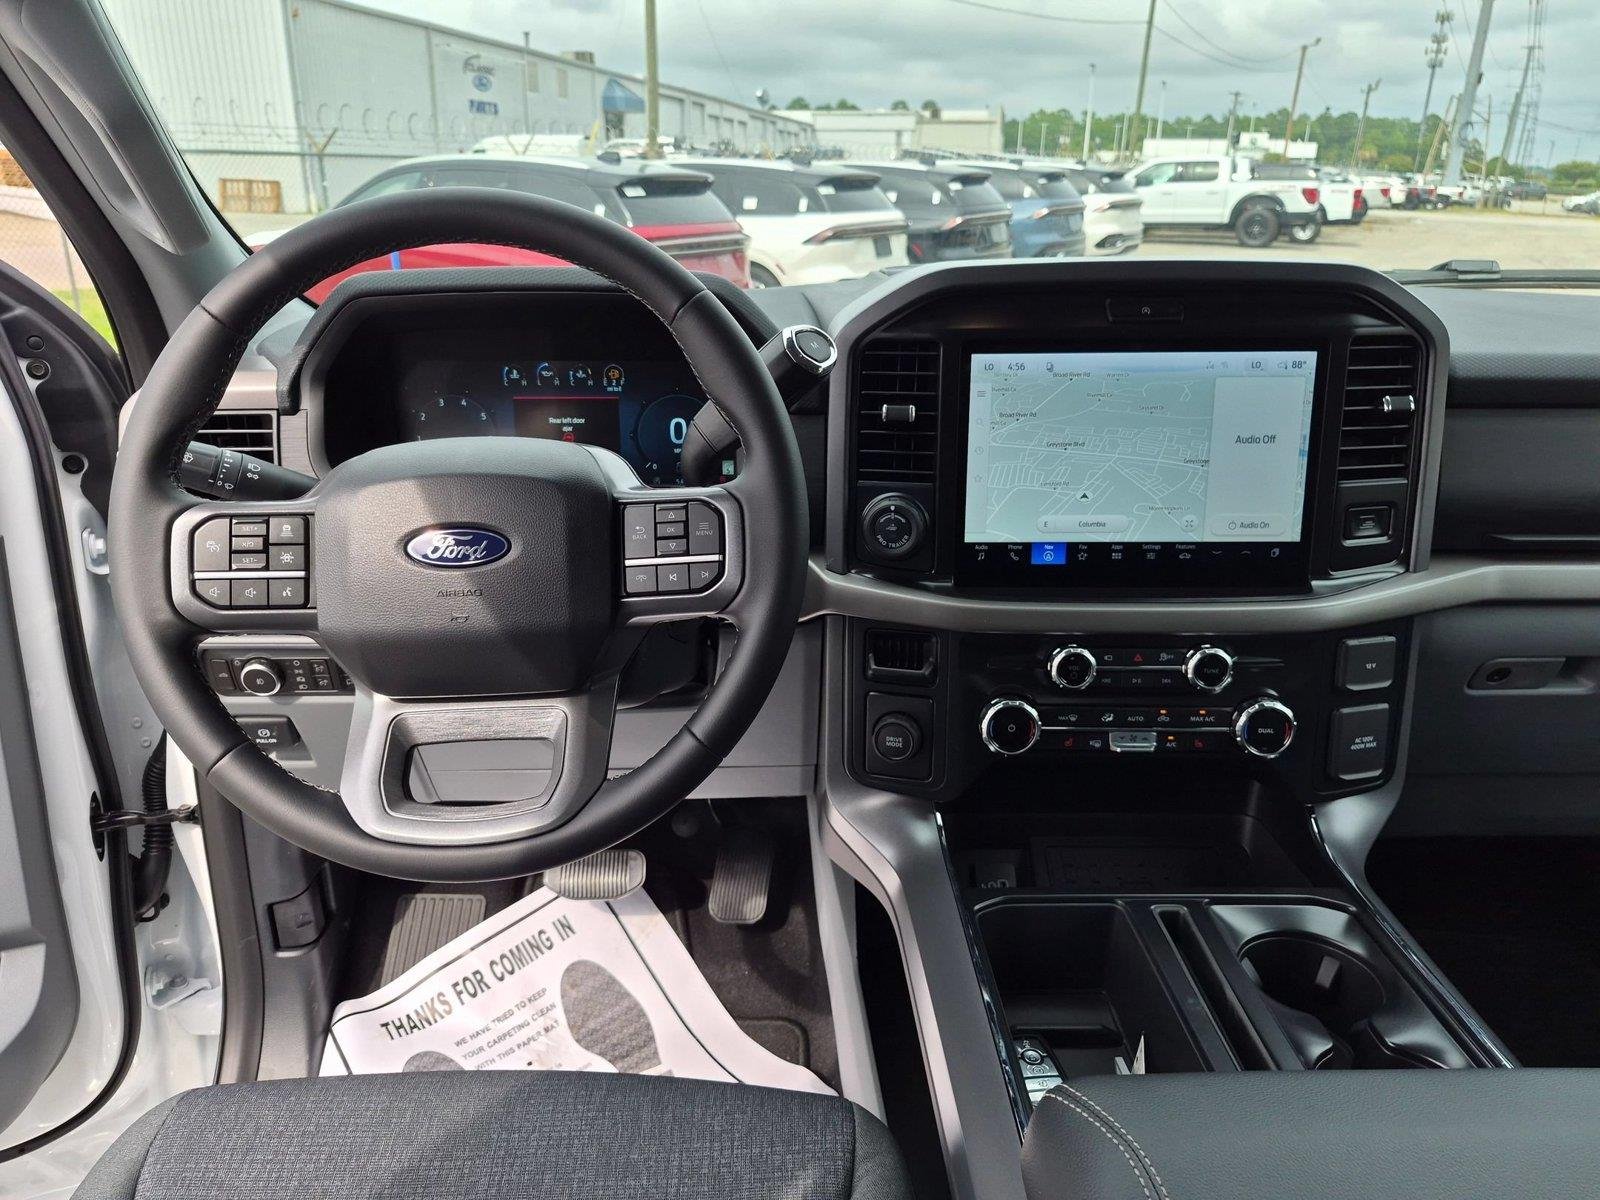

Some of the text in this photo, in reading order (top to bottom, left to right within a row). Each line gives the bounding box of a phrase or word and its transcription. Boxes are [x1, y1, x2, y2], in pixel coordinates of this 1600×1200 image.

[984, 363, 995, 371] LO
[1007, 362, 1026, 371] 4:56
[1251, 361, 1262, 369] LO
[439, 399, 445, 407] 3
[461, 399, 467, 407] 4
[420, 413, 426, 421] 2
[669, 417, 687, 444] 0
[1235, 435, 1276, 444] Audio Off
[1046, 441, 1074, 449] Greystone
[876, 534, 909, 548] PRO TRAILER
[426, 534, 488, 561] Ford
[437, 589, 483, 598] AIRBAG
[380, 913, 577, 1041] THANKS FOR COMING IN
[454, 988, 547, 1048] WE HAVE TRIED TO KEEP
[462, 1002, 557, 1060] YOUR CARPETING CLEAN
[474, 1019, 560, 1071] WITH THIS PAPER MAT
